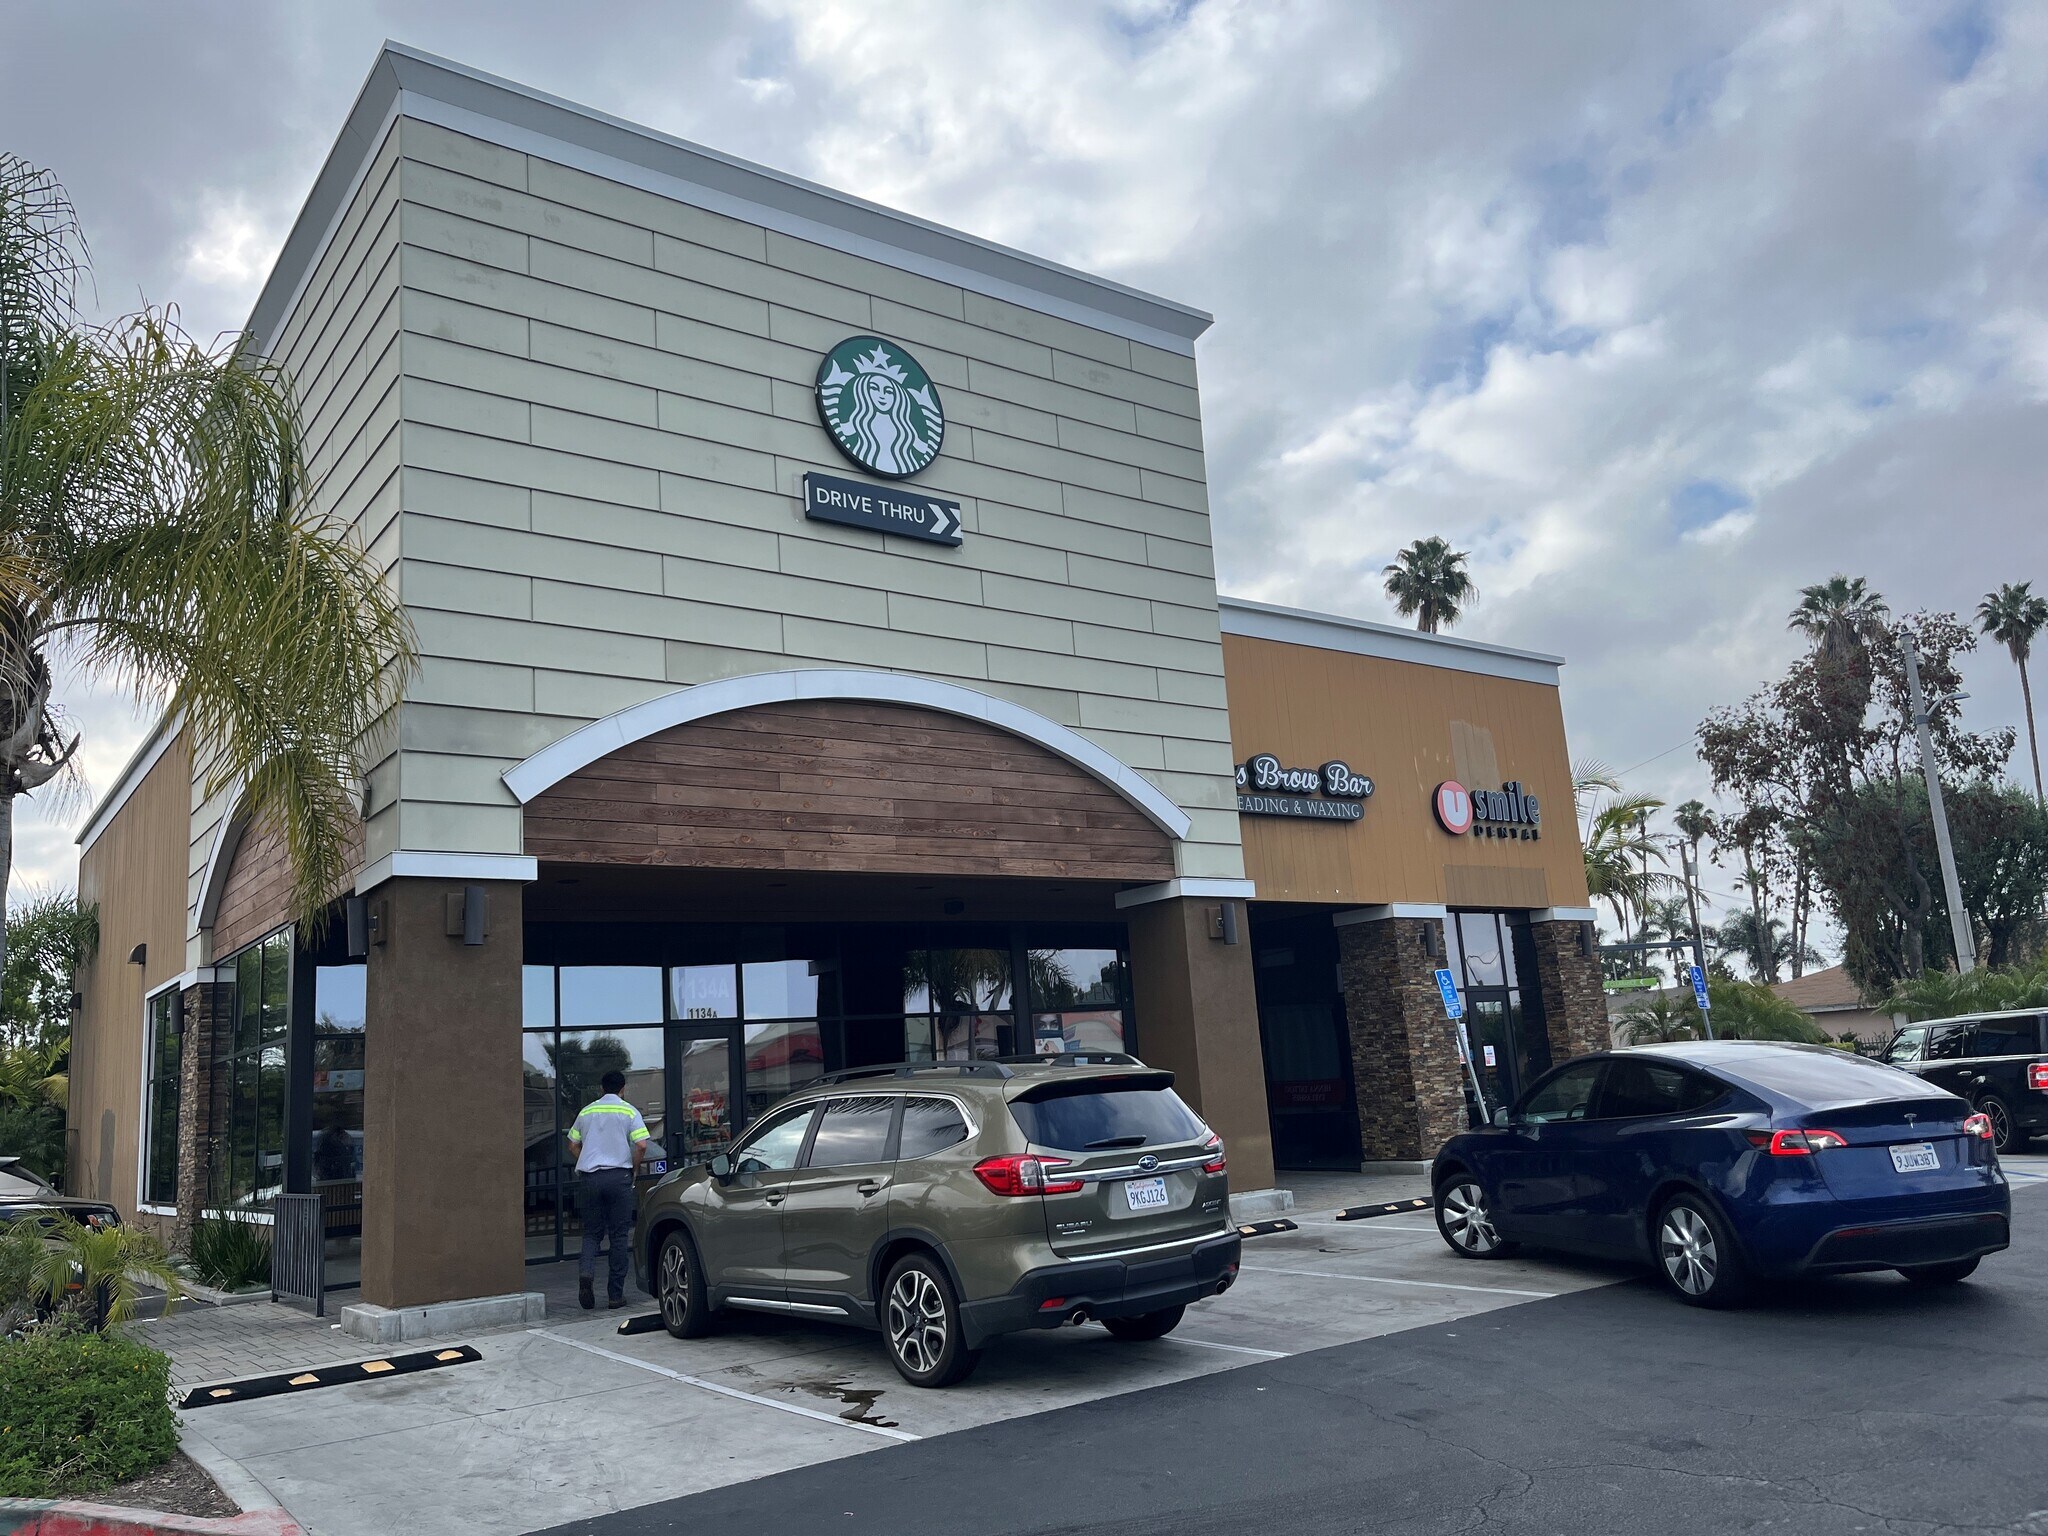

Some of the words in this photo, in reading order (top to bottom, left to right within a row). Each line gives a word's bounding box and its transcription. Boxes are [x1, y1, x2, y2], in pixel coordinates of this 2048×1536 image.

[816, 487, 873, 513] DRIVE
[878, 499, 925, 523] THRU
[1255, 756, 1320, 790] Brow
[1327, 763, 1373, 794] Bar
[1293, 799, 1302, 814] &
[1306, 801, 1360, 818] WAXING
[1474, 780, 1541, 824] smile
[1473, 824, 1541, 841] DENTAL
[1895, 1152, 1936, 1169] 9JUW387
[1130, 1188, 1166, 1206] 9KGJ126
